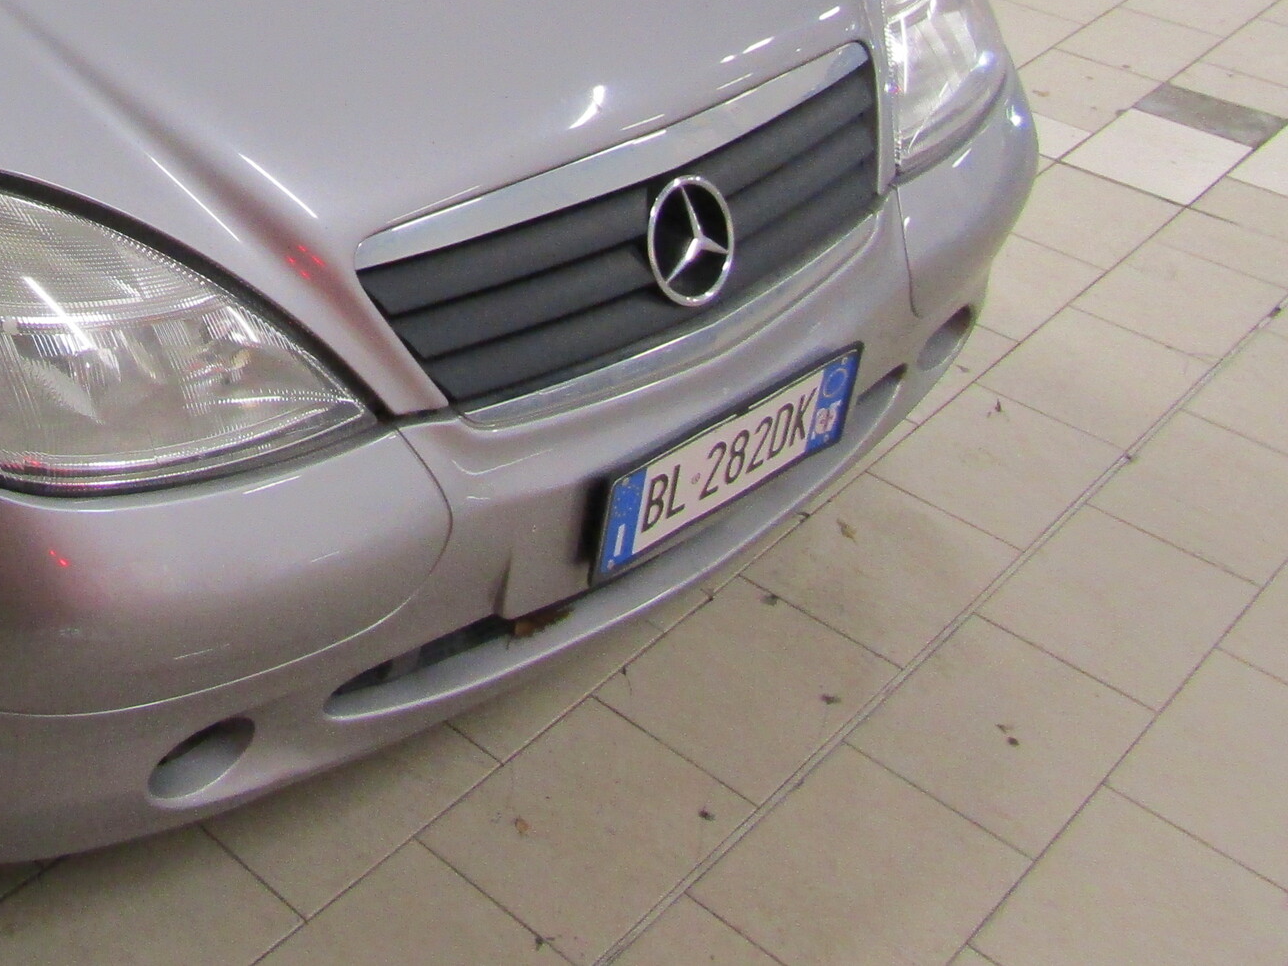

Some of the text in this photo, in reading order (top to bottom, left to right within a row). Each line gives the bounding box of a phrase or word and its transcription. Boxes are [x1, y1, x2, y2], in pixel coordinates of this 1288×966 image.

[640, 386, 818, 534] BL 282DK
[613, 523, 626, 557] I
